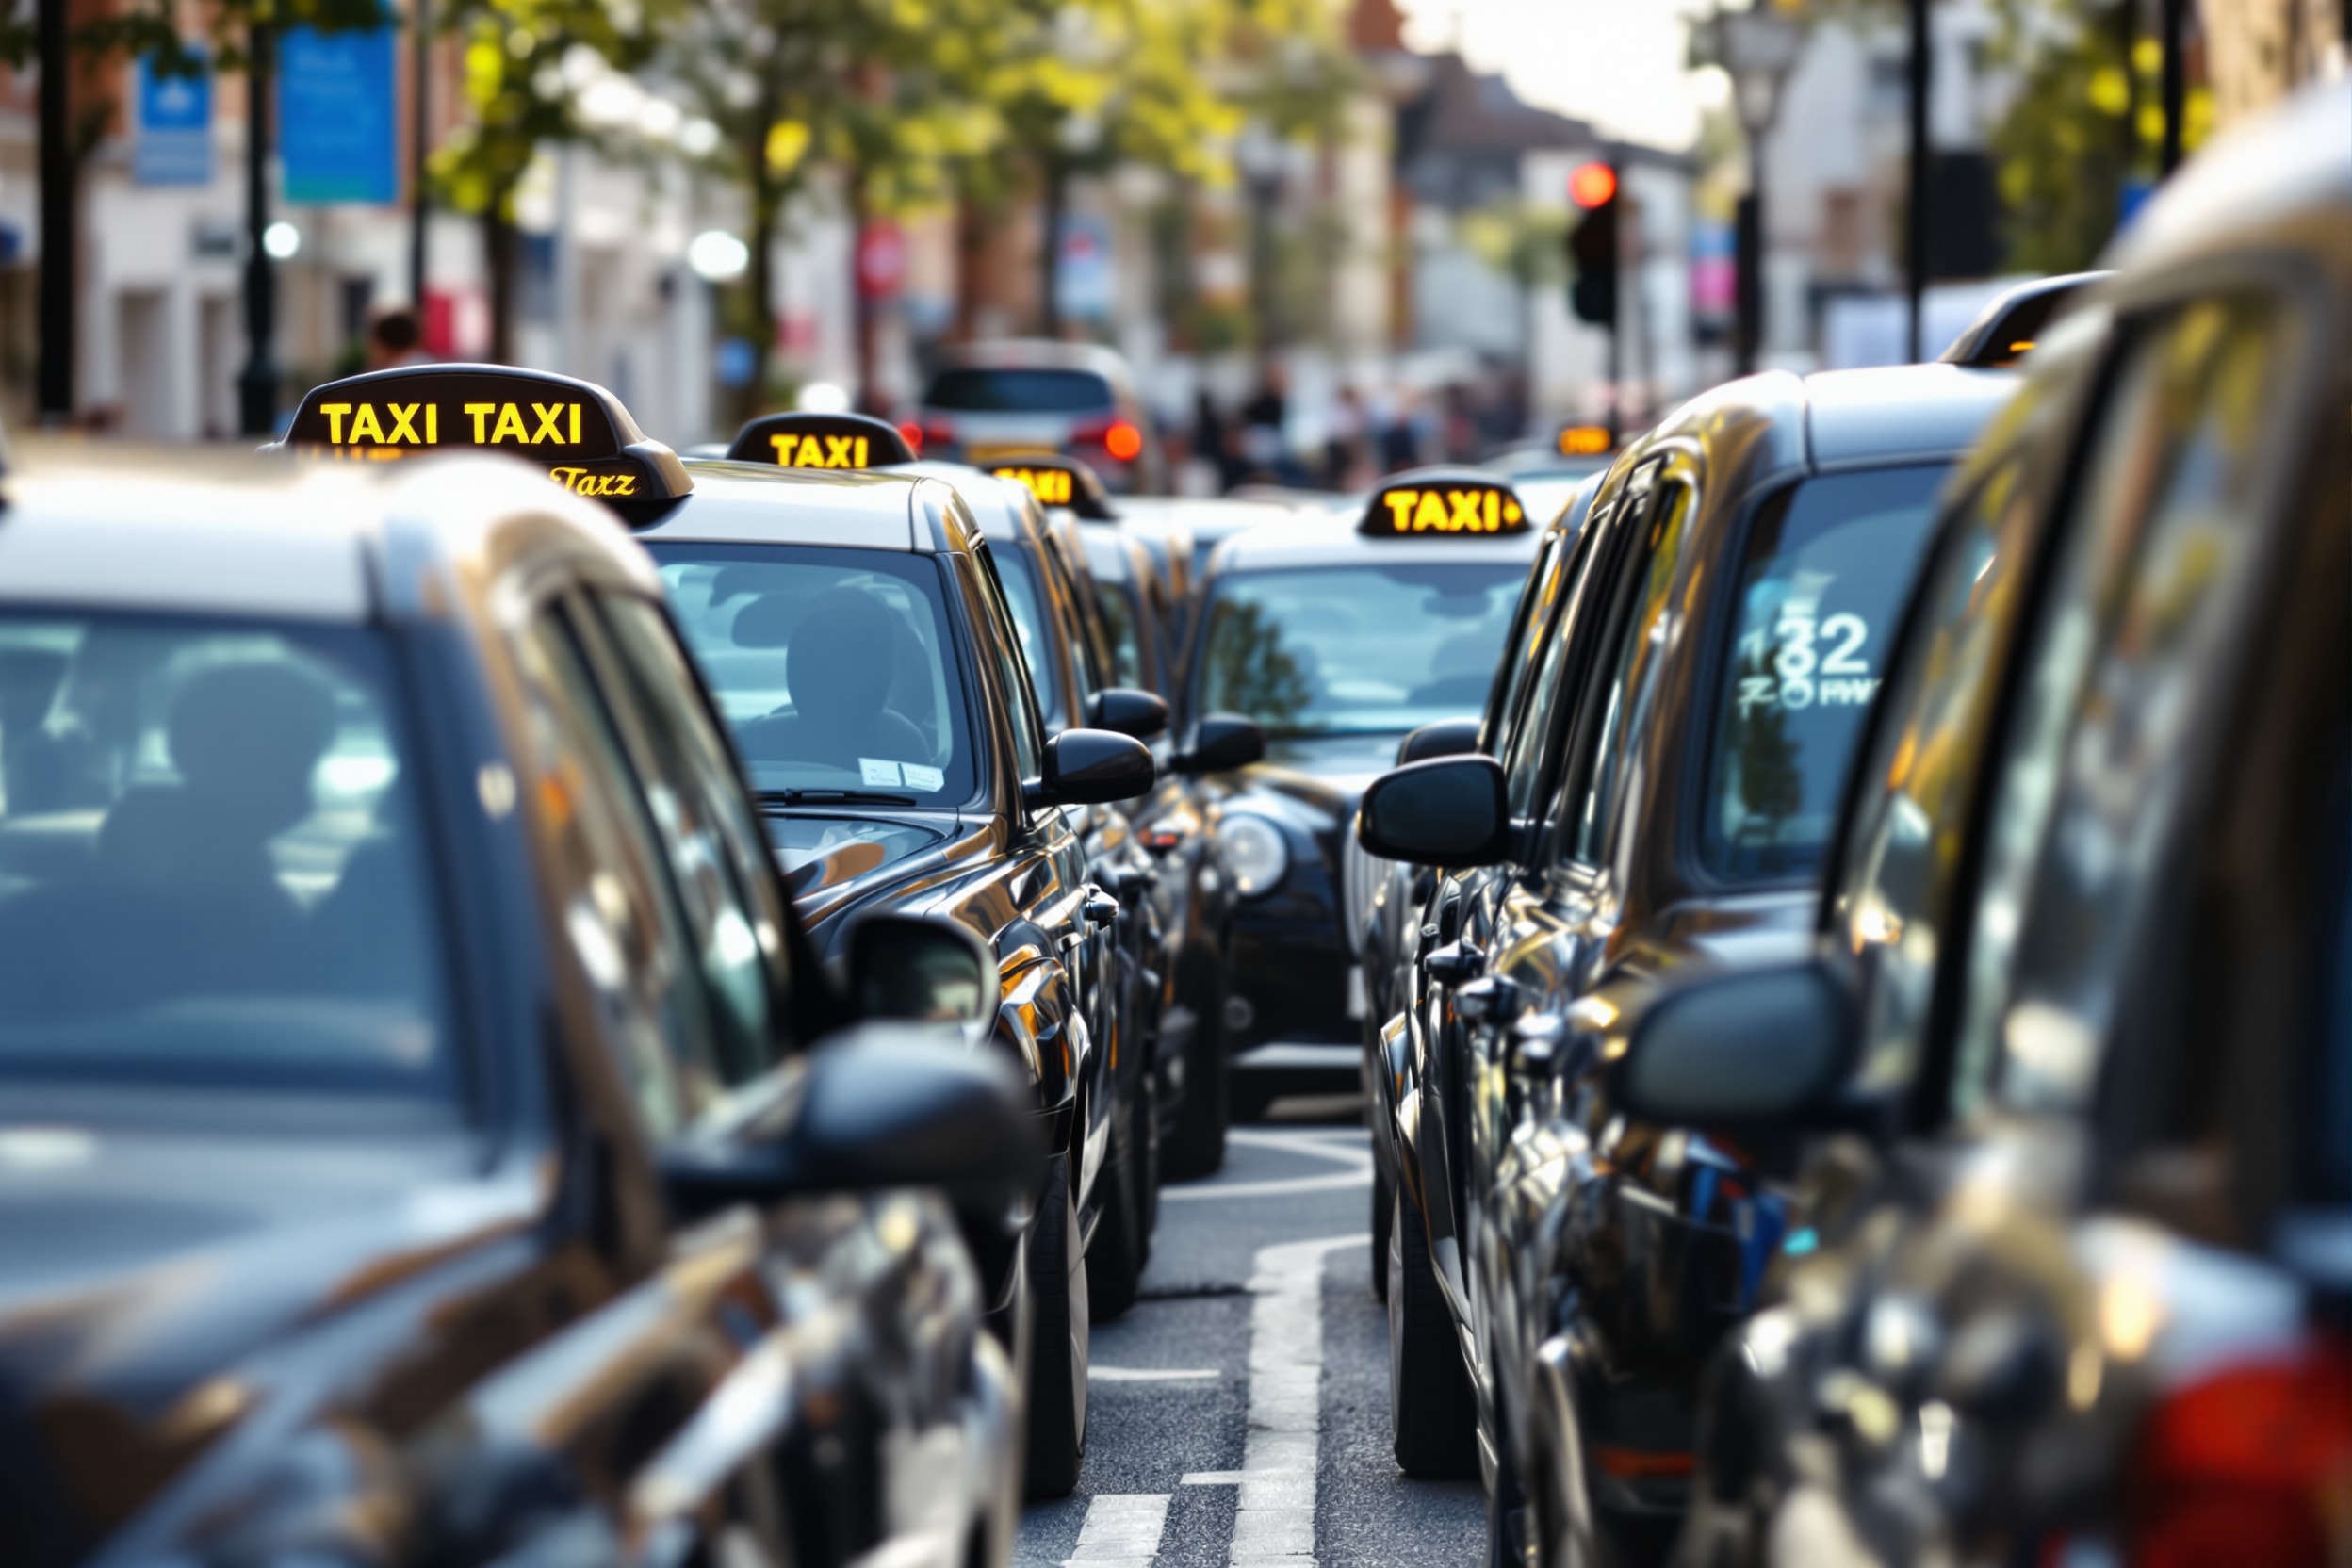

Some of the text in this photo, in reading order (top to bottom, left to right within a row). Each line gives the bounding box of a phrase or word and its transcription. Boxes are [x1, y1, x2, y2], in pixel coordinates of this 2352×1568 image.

[319, 402, 581, 445] TAXI TAXI
[769, 433, 869, 469] TAXI
[1383, 488, 1501, 532] TAXI
